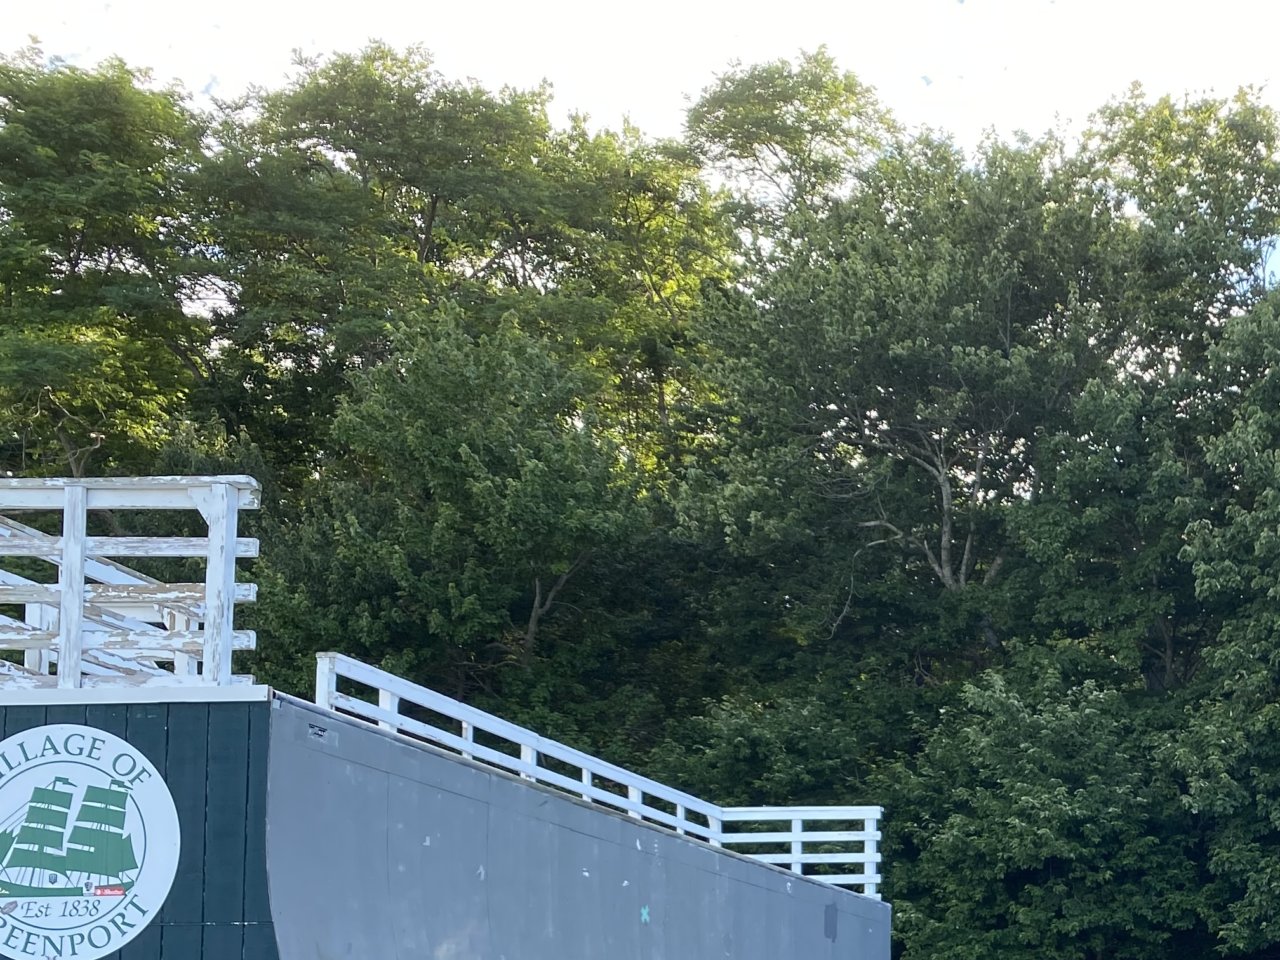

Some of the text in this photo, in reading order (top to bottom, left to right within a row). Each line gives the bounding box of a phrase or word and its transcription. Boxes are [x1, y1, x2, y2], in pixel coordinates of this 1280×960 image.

[0, 733, 152, 786] LLAGE OF
[0, 894, 149, 957] EENPORT
[21, 899, 101, 918] Est 1838
